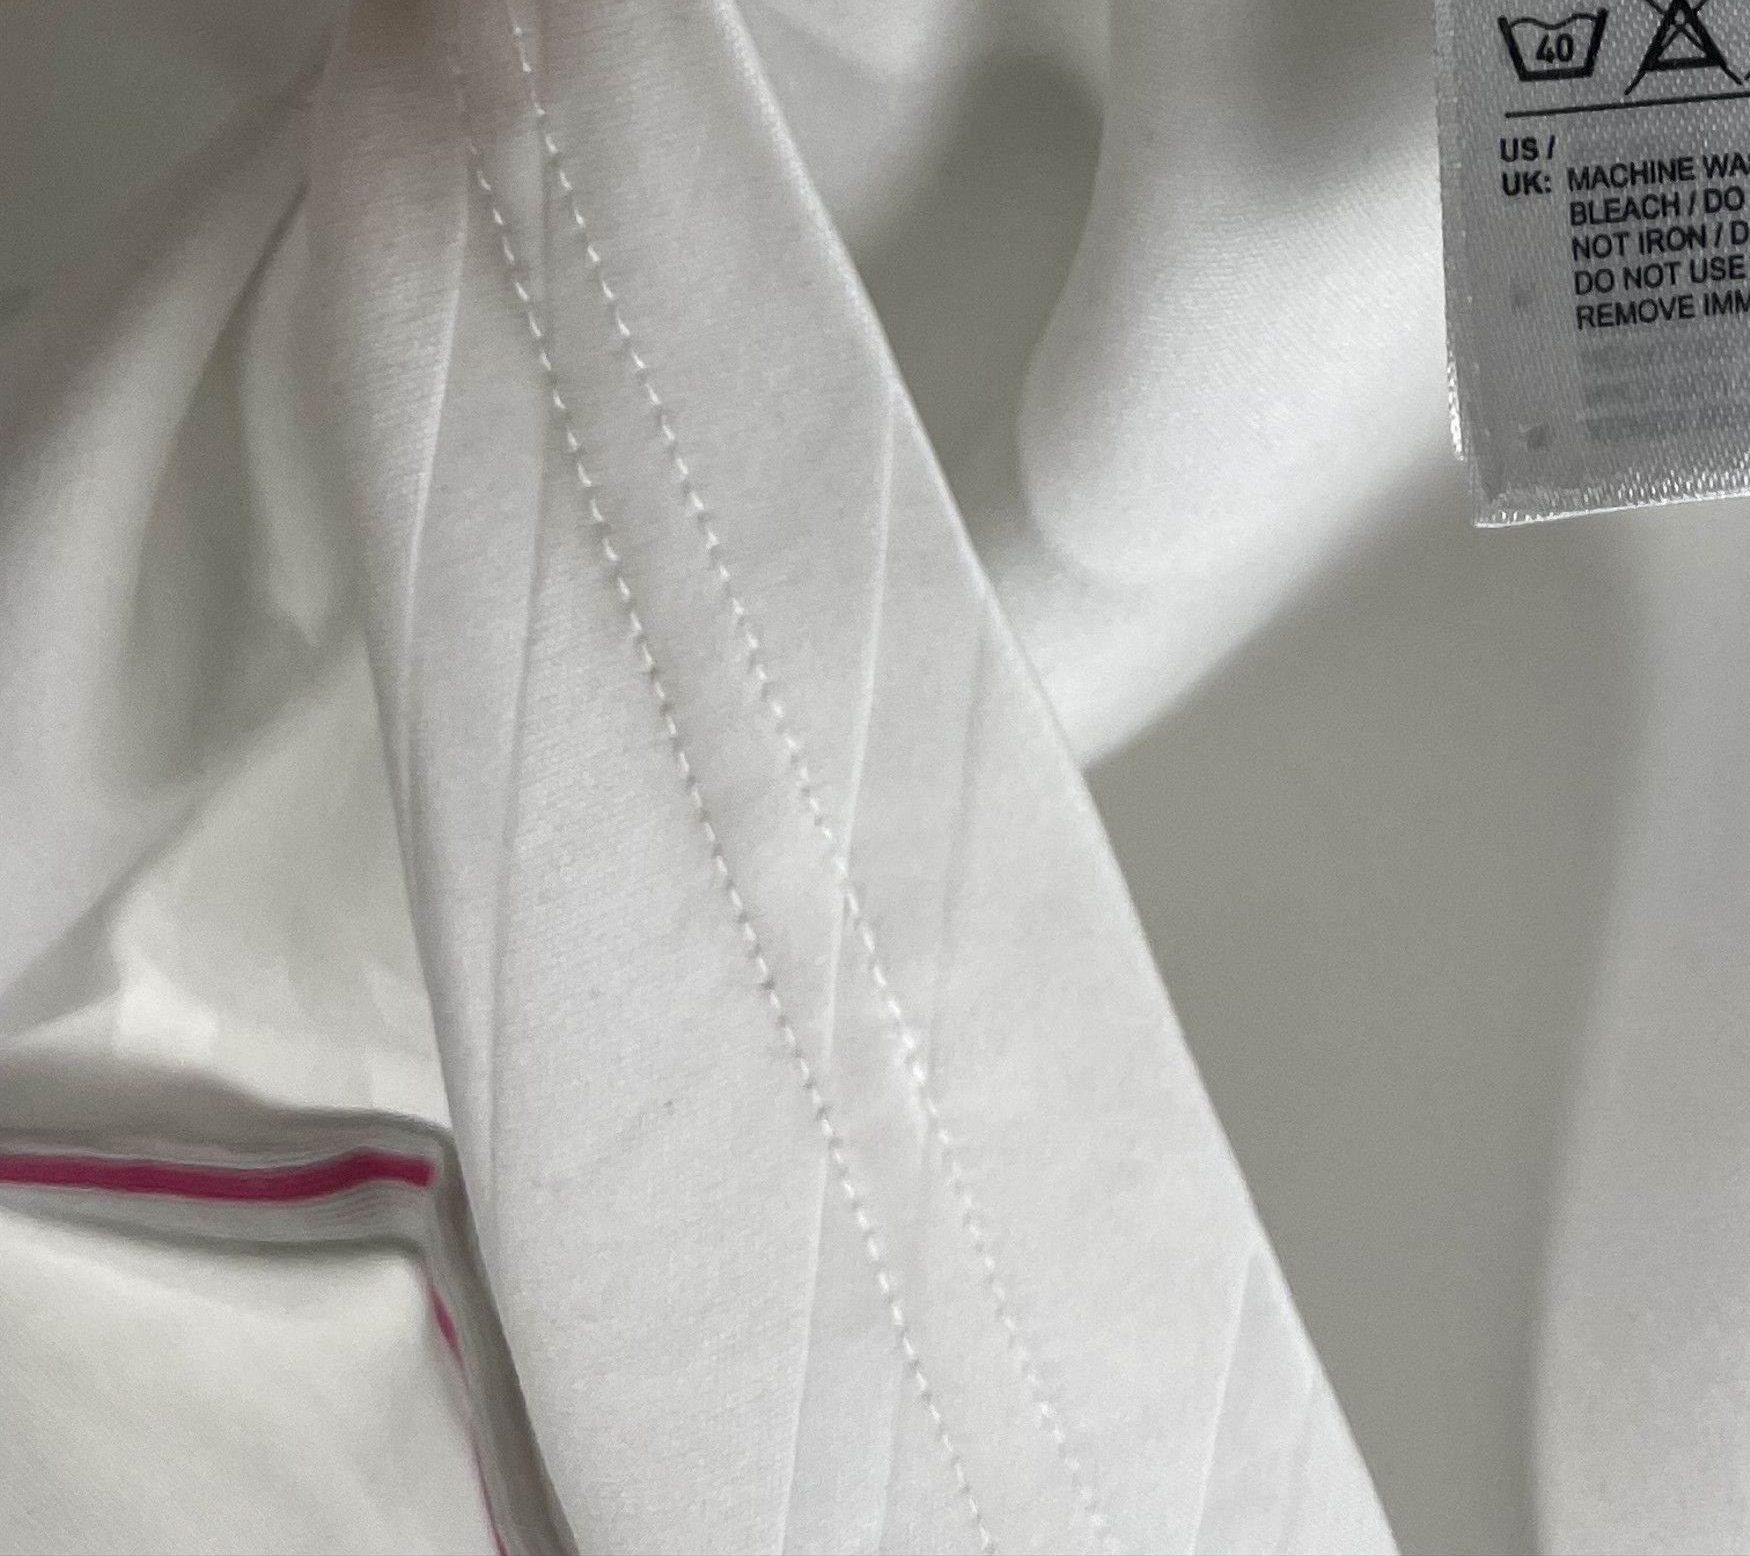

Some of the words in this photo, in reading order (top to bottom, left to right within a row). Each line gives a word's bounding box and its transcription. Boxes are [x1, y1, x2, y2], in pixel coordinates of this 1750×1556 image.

[1536, 33, 1573, 63] 40
[1500, 137, 1539, 162] US
[1548, 135, 1555, 158] /
[1502, 170, 1551, 196] UK:
[1568, 157, 1696, 191] MACHINE
[1570, 192, 1680, 226] BLEACH
[1688, 191, 1696, 216] /
[1704, 186, 1745, 213] DO
[1572, 232, 1630, 261] NOT
[1639, 223, 1706, 255] IRON
[1715, 222, 1723, 247] /
[1575, 269, 1614, 294] DO
[1623, 262, 1681, 290] NOT
[1690, 254, 1745, 283] USE
[1576, 294, 1695, 330] REMOVE
